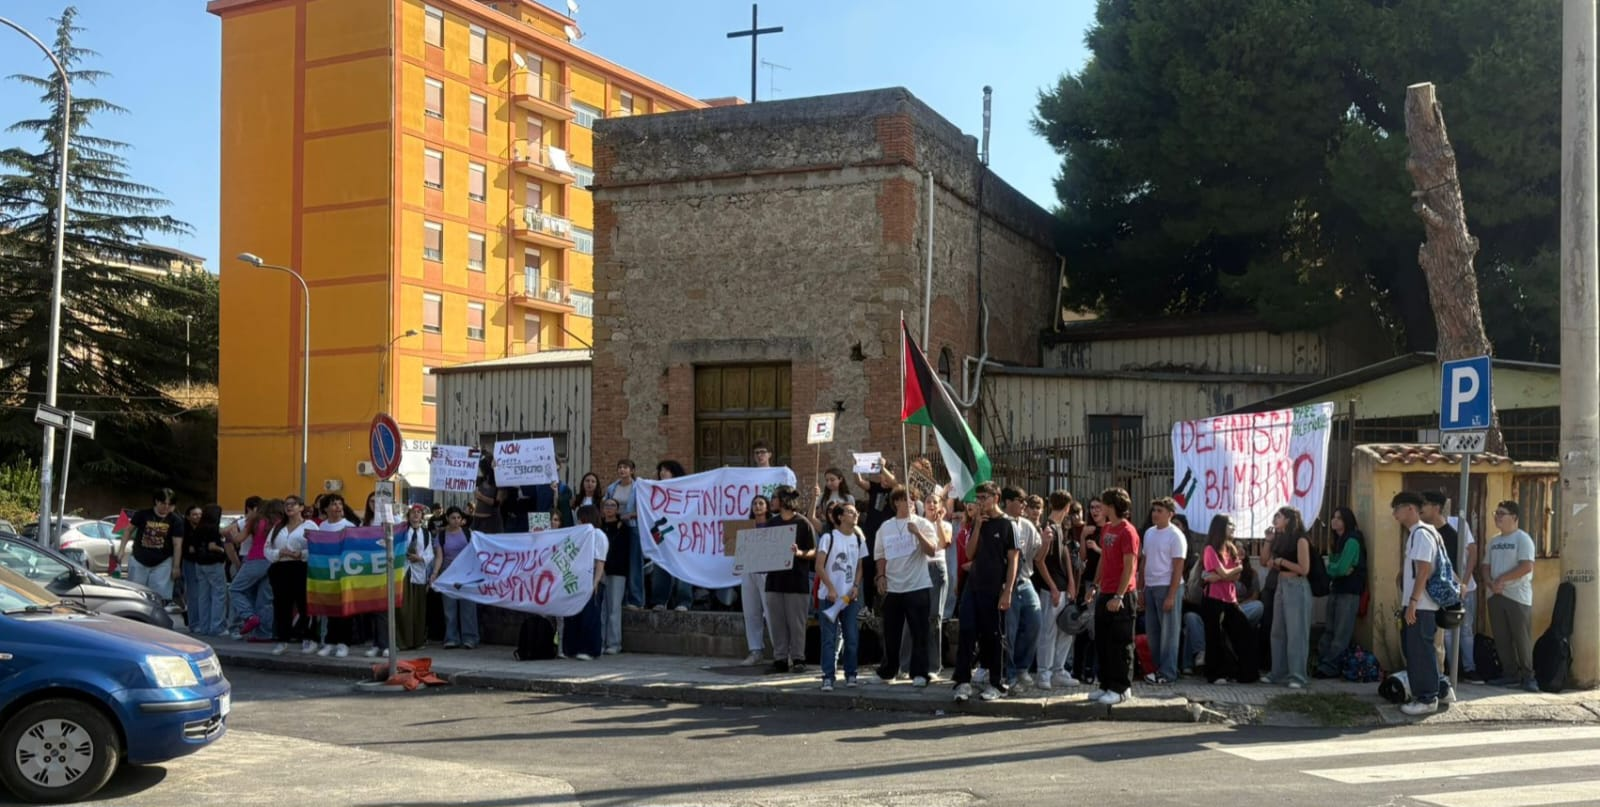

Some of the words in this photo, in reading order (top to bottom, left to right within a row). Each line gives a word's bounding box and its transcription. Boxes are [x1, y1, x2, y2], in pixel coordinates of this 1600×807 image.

[1450, 366, 1480, 423] P
[412, 440, 433, 450] SIC
[499, 442, 521, 455] NON
[1181, 410, 1292, 456] DEFINISCI
[1205, 452, 1315, 513] BAMBINO
[678, 520, 724, 555] BAMB
[328, 552, 388, 580] PCE
